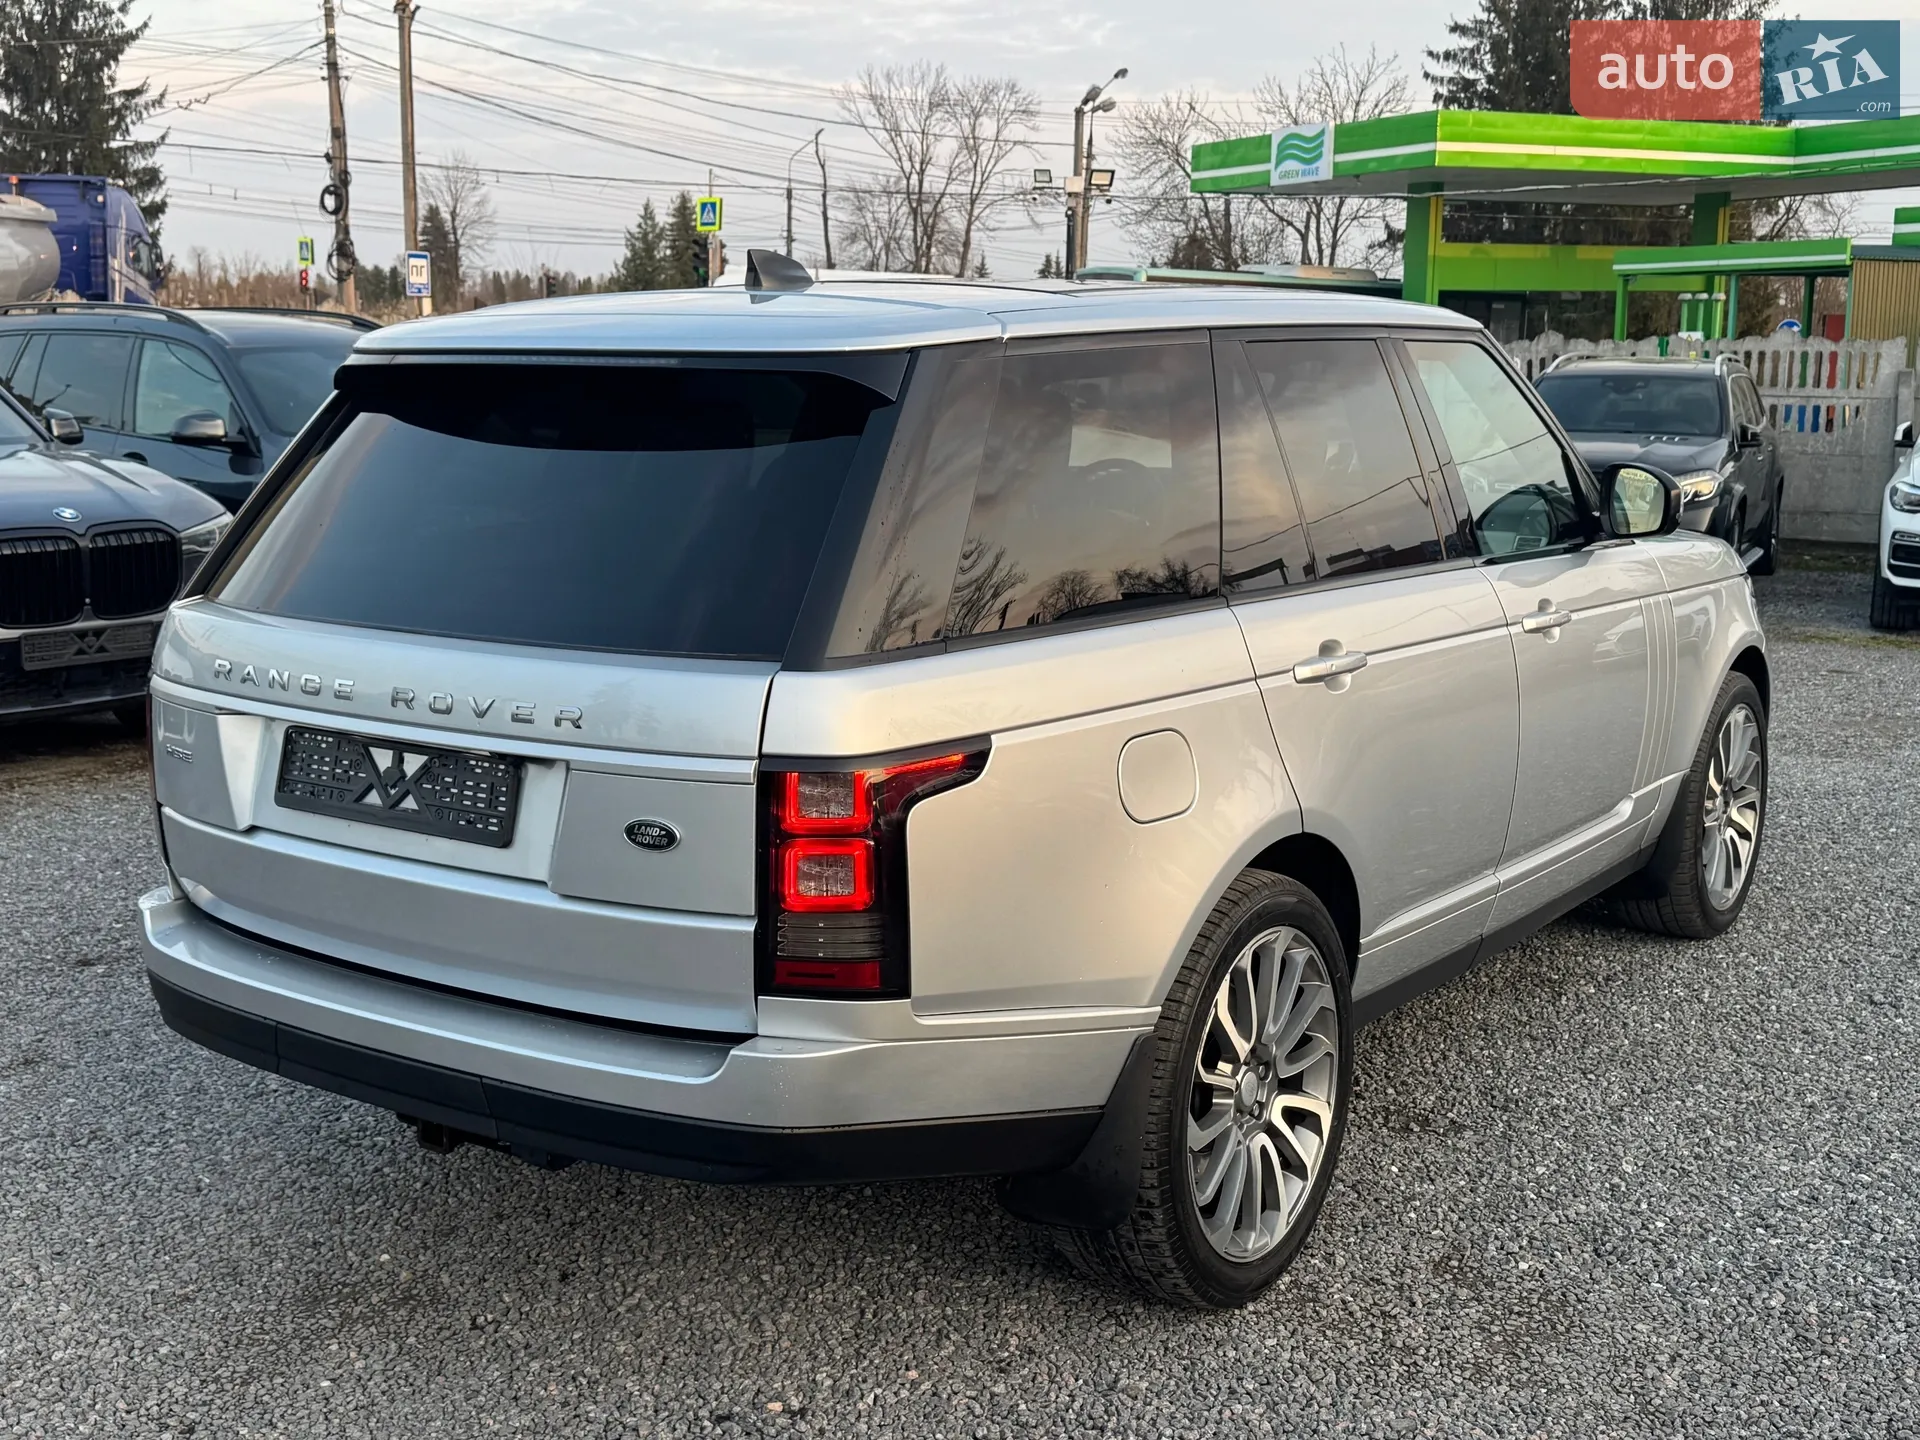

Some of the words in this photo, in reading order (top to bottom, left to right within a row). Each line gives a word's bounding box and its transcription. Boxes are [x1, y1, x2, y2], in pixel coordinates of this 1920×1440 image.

[1278, 169, 1300, 180] GREEN
[1300, 166, 1319, 177] WAVE
[213, 657, 356, 702] RANGE
[390, 685, 584, 730] ROVER
[633, 824, 660, 836] LAND
[635, 834, 668, 847] ROVER
